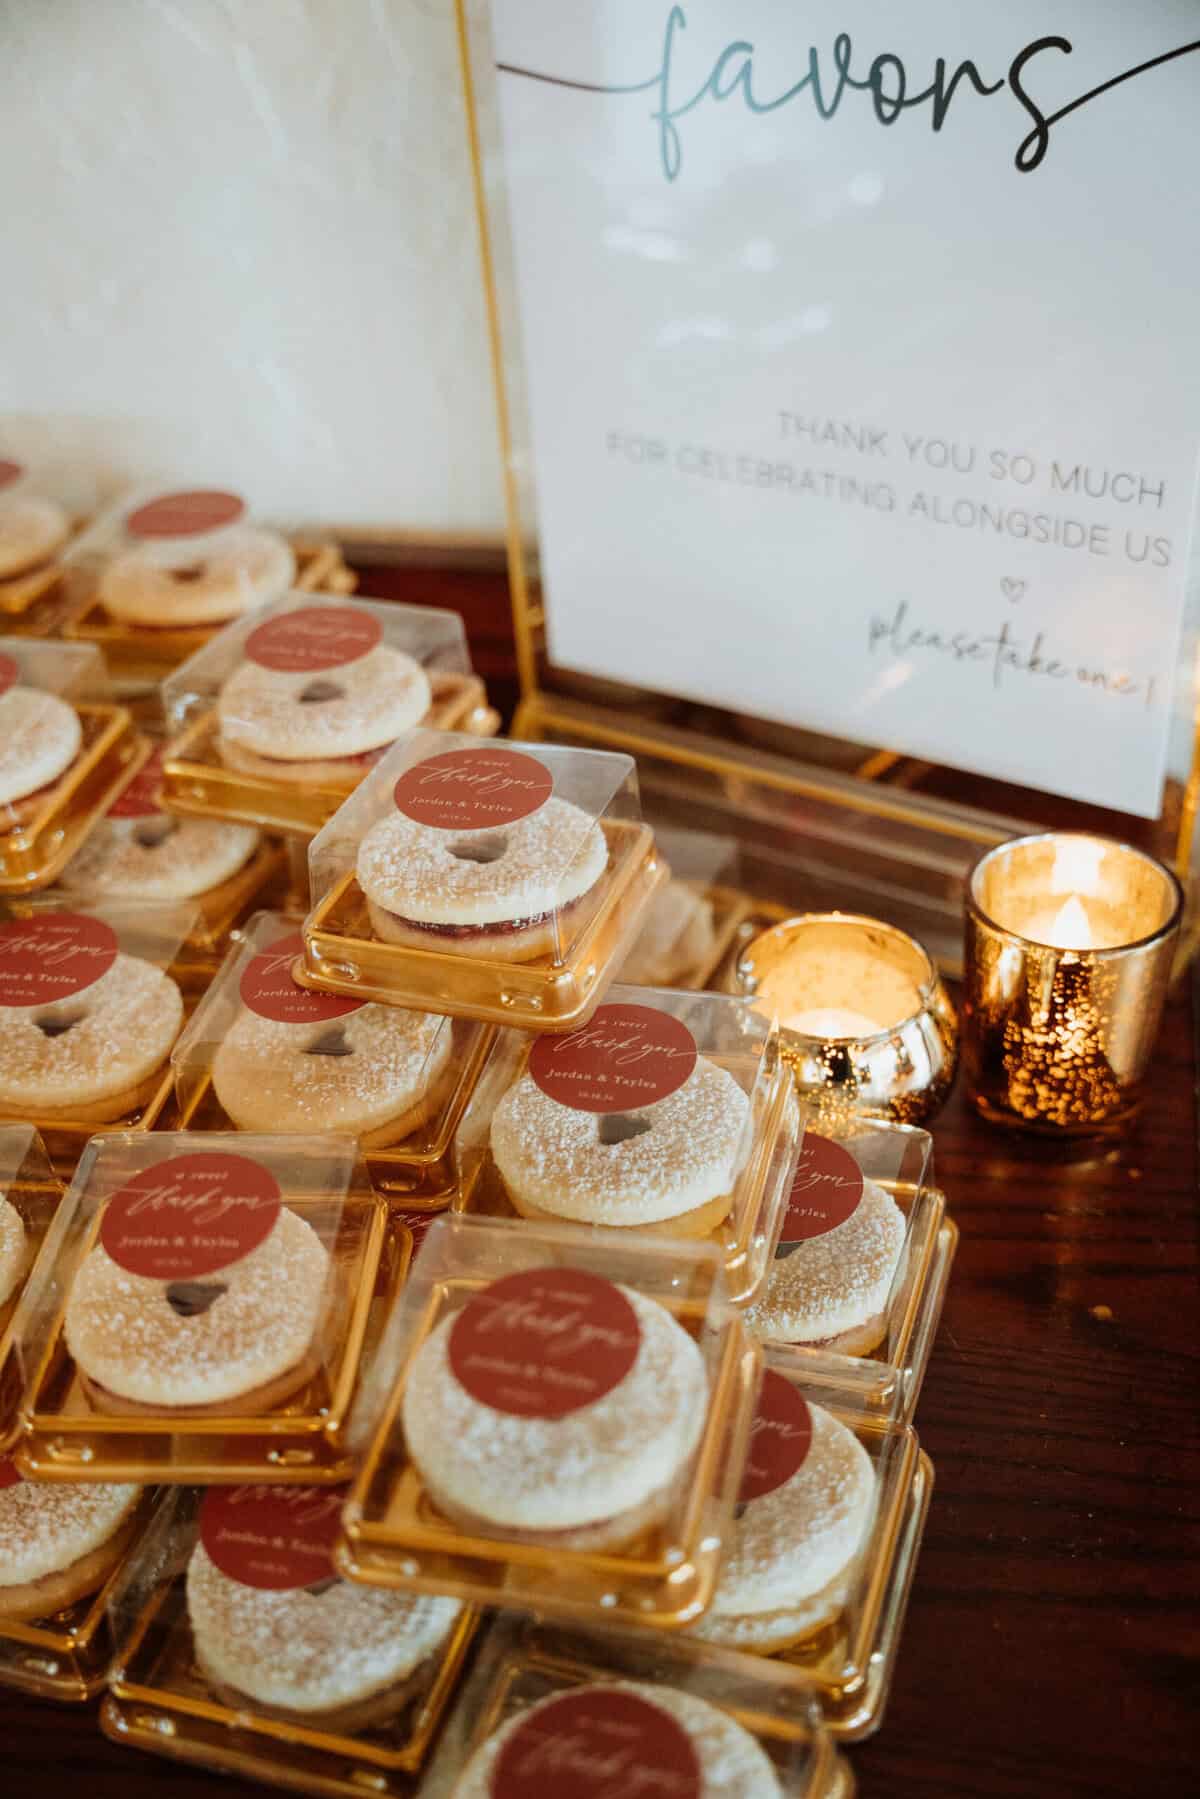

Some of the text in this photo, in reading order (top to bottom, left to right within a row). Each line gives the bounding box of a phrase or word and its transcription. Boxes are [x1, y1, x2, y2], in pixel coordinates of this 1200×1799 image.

[496, 4, 1200, 174] favors
[777, 411, 1168, 510] THANK YOU SO MUCH
[605, 431, 1173, 568] FOR CELEBRATING ALONGSIDE US
[867, 600, 985, 661] please
[979, 620, 1068, 691] take
[457, 800, 468, 808] &
[476, 775, 553, 796] you
[545, 1068, 592, 1081] Jordan
[596, 1073, 608, 1083] &
[615, 1044, 698, 1065] you
